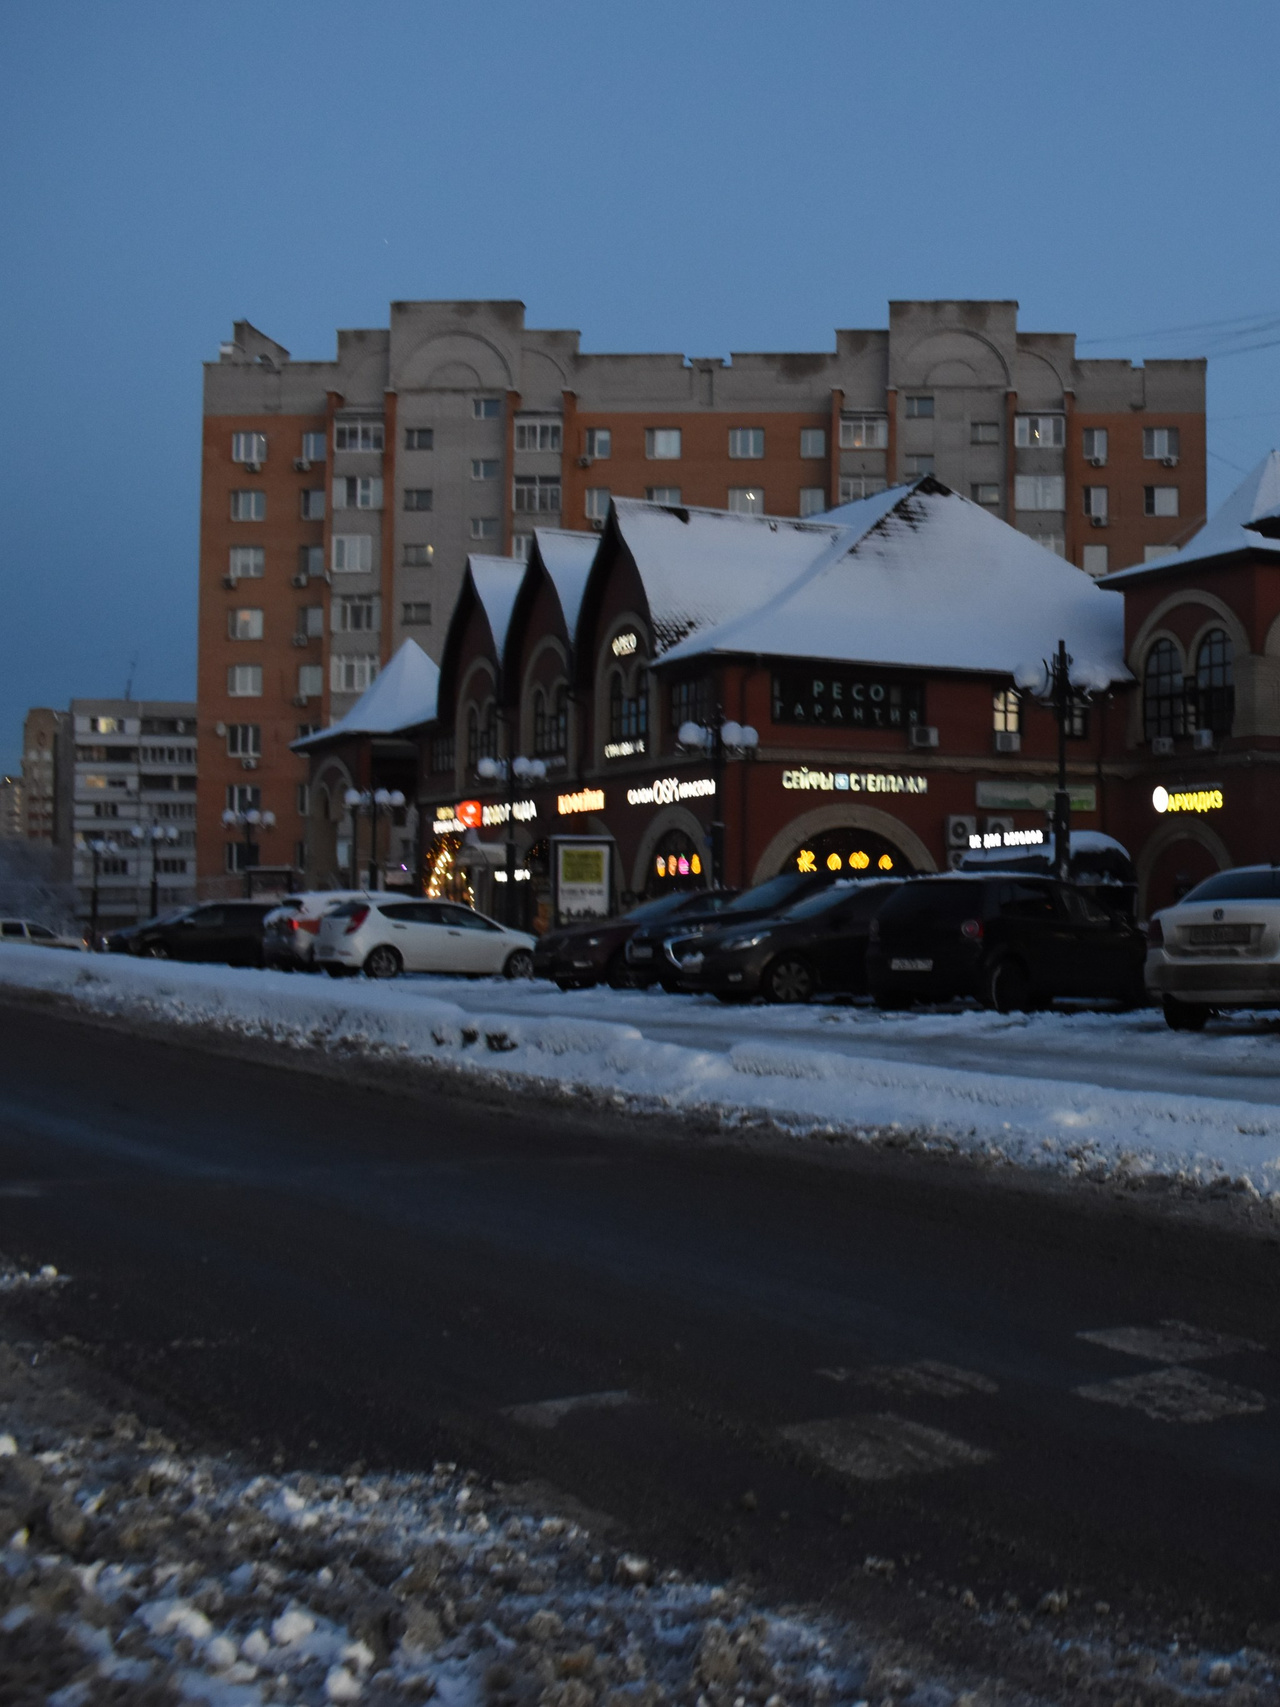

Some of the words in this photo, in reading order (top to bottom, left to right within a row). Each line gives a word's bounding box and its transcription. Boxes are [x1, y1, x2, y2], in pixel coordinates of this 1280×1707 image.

[812, 679, 885, 702] РЕСО
[774, 700, 918, 724] ГАРАНТИЯ
[782, 766, 834, 790] СЕЙФЫ
[849, 772, 927, 793] СТЕЛЛАЖИ
